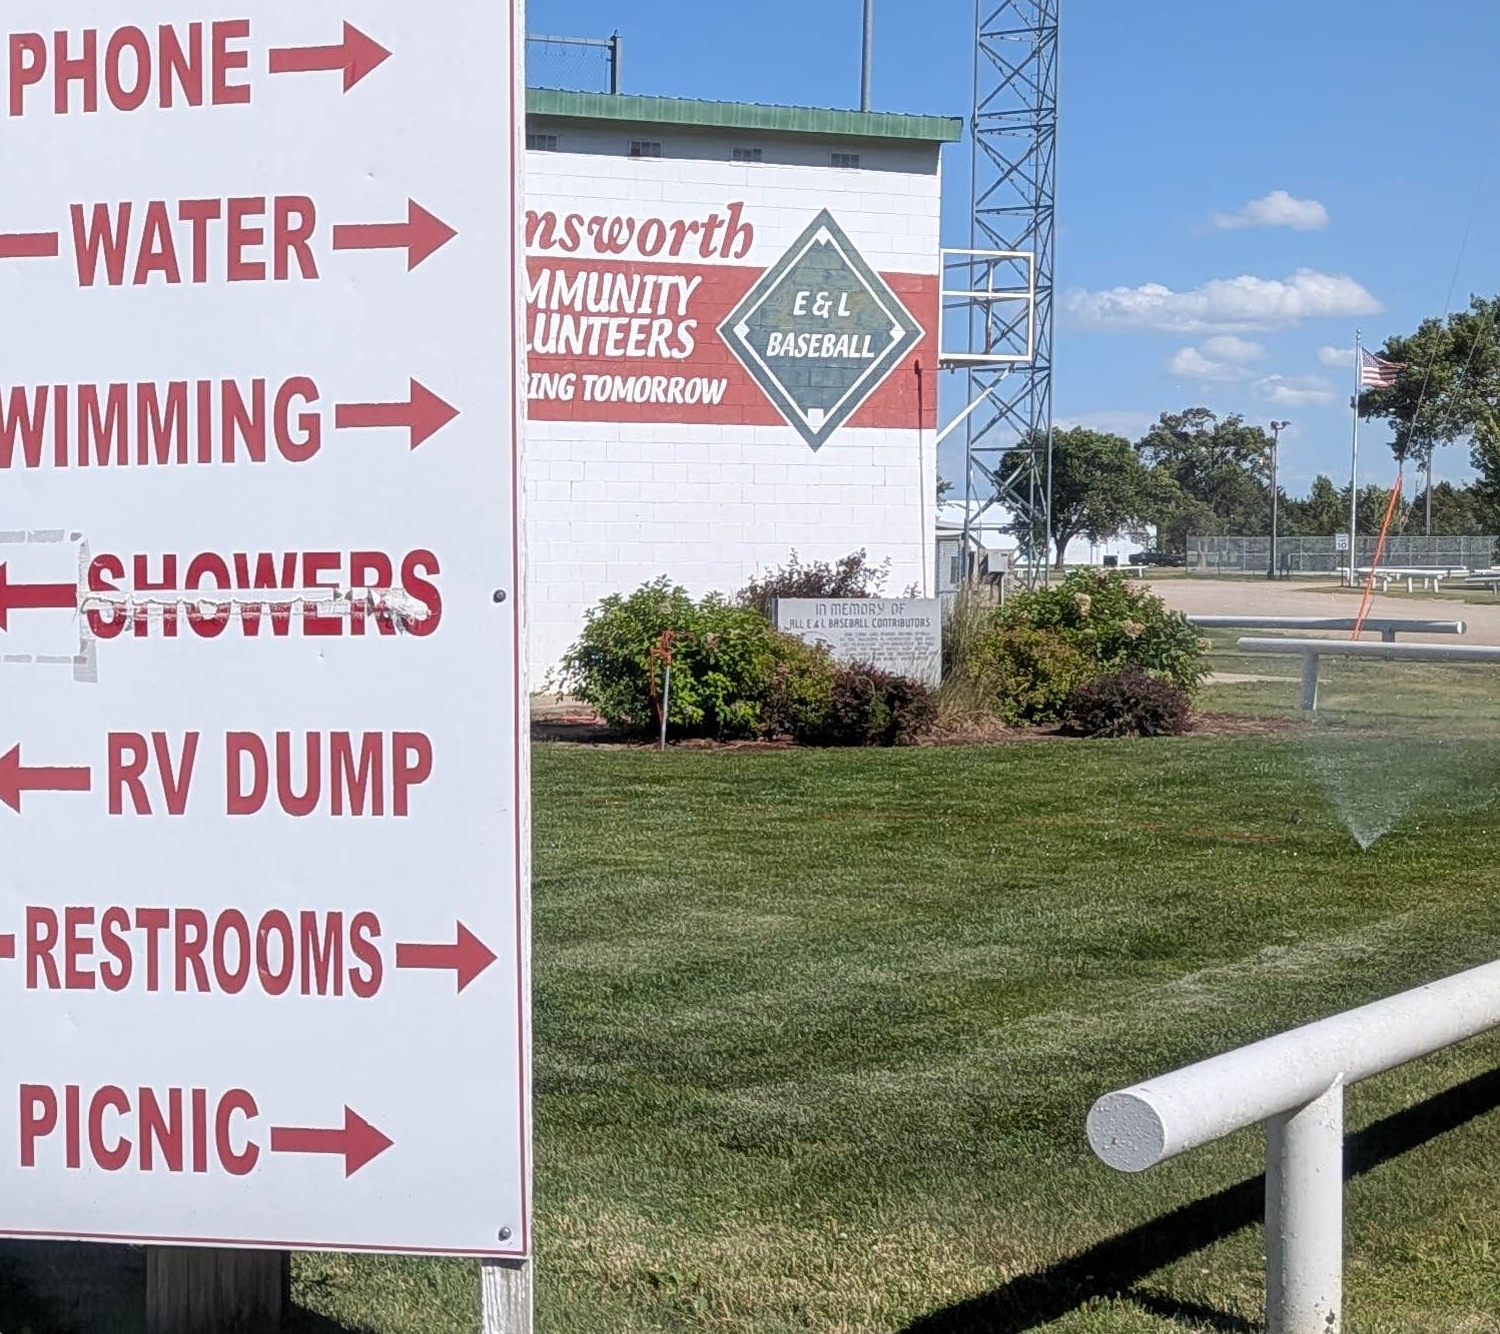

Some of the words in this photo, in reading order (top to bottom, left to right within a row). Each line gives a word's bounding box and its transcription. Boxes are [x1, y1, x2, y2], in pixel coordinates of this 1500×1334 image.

[8, 18, 252, 117] PHONE
[69, 194, 320, 287] WATER
[526, 312, 698, 359] UNTEERS
[793, 291, 810, 316] E
[812, 291, 833, 319] &
[837, 292, 851, 317] L
[766, 332, 875, 358] BASEBALL
[526, 372, 577, 401] ING
[582, 374, 728, 405] TOMORROW
[87, 548, 443, 638] SHOWERS
[789, 619, 804, 629] ALL
[828, 619, 869, 629] BASEBALL
[871, 617, 931, 629] CONTRIBUTORS
[830, 603, 885, 616] MEMORY
[891, 602, 906, 615] OF
[106, 731, 200, 816] RV
[225, 731, 433, 817] DUMP
[24, 905, 384, 998] RESTROOMS
[18, 1083, 261, 1176] PICNIC
